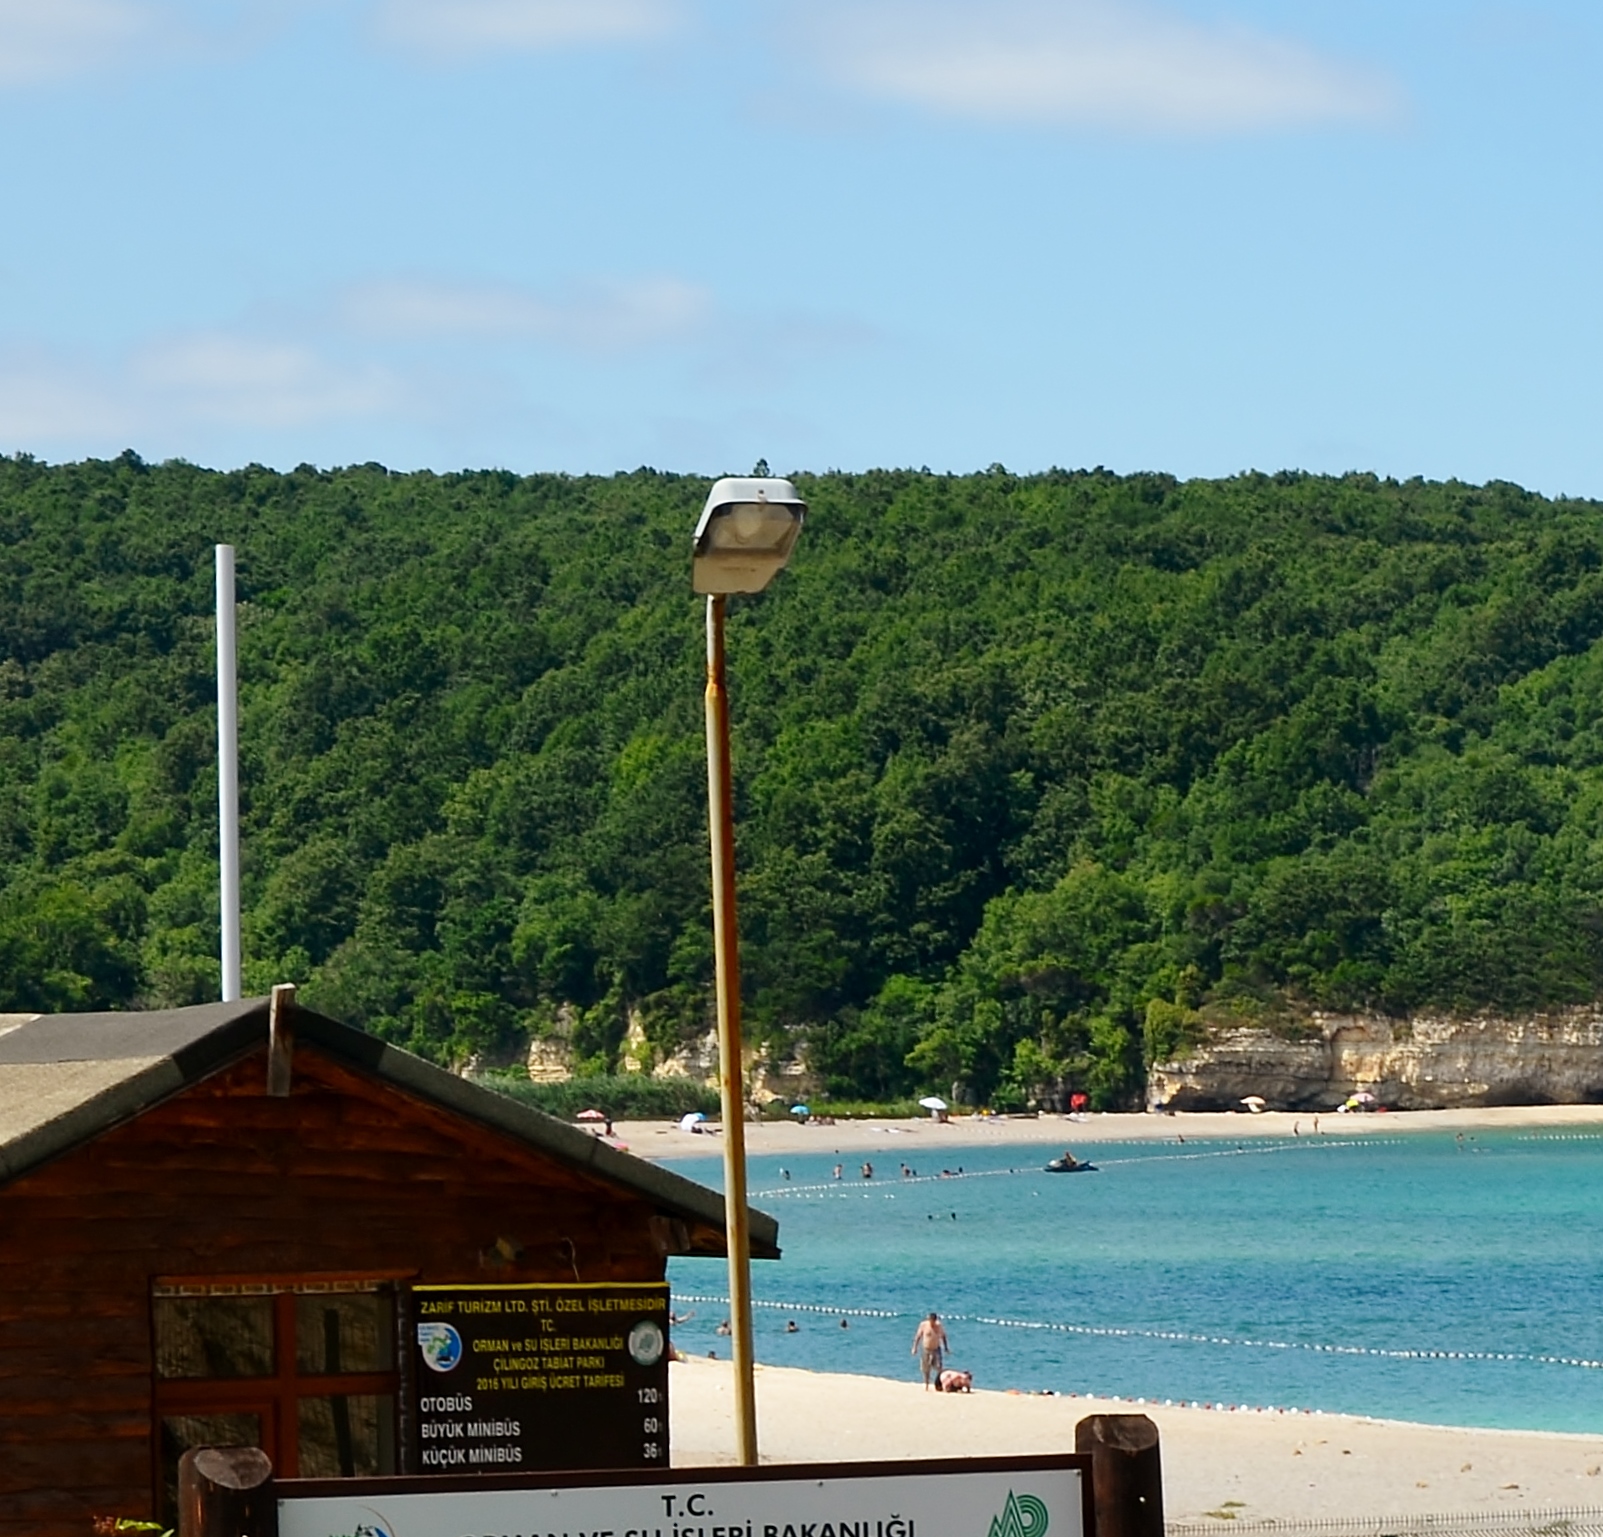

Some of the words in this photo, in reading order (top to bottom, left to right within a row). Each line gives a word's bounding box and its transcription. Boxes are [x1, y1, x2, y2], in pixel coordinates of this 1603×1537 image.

[420, 1300, 454, 1314] ZARİF
[458, 1300, 502, 1314] TURİZM
[504, 1301, 529, 1313] LTD.
[532, 1300, 552, 1316] ŞTİ.
[555, 1299, 584, 1312] ÖZEL
[588, 1298, 666, 1314] İŞLETMESİDİR
[472, 1339, 510, 1353] ORMAN
[512, 1342, 522, 1351] ve
[525, 1339, 538, 1351] SU
[540, 1337, 570, 1354] İŞLERİ
[572, 1336, 624, 1350] BAKANLIĞI
[542, 1356, 574, 1369] TABİAT
[576, 1356, 605, 1368] PARKI
[501, 1377, 519, 1390] YILI
[521, 1375, 548, 1392] GİRİŞ
[549, 1374, 581, 1389] ÜCRET
[583, 1373, 625, 1388] TARİFESİ
[420, 1393, 473, 1413] OTOBÜS
[637, 1388, 658, 1403] 120
[421, 1420, 464, 1439] BÜYÜK
[467, 1417, 521, 1437] MİNİBÜS
[643, 1417, 658, 1434] 60
[422, 1446, 466, 1468] KÜÇÜK
[468, 1443, 523, 1465] MİNİBÜS
[643, 1443, 658, 1459] 36
[661, 1493, 714, 1518] T.C.
